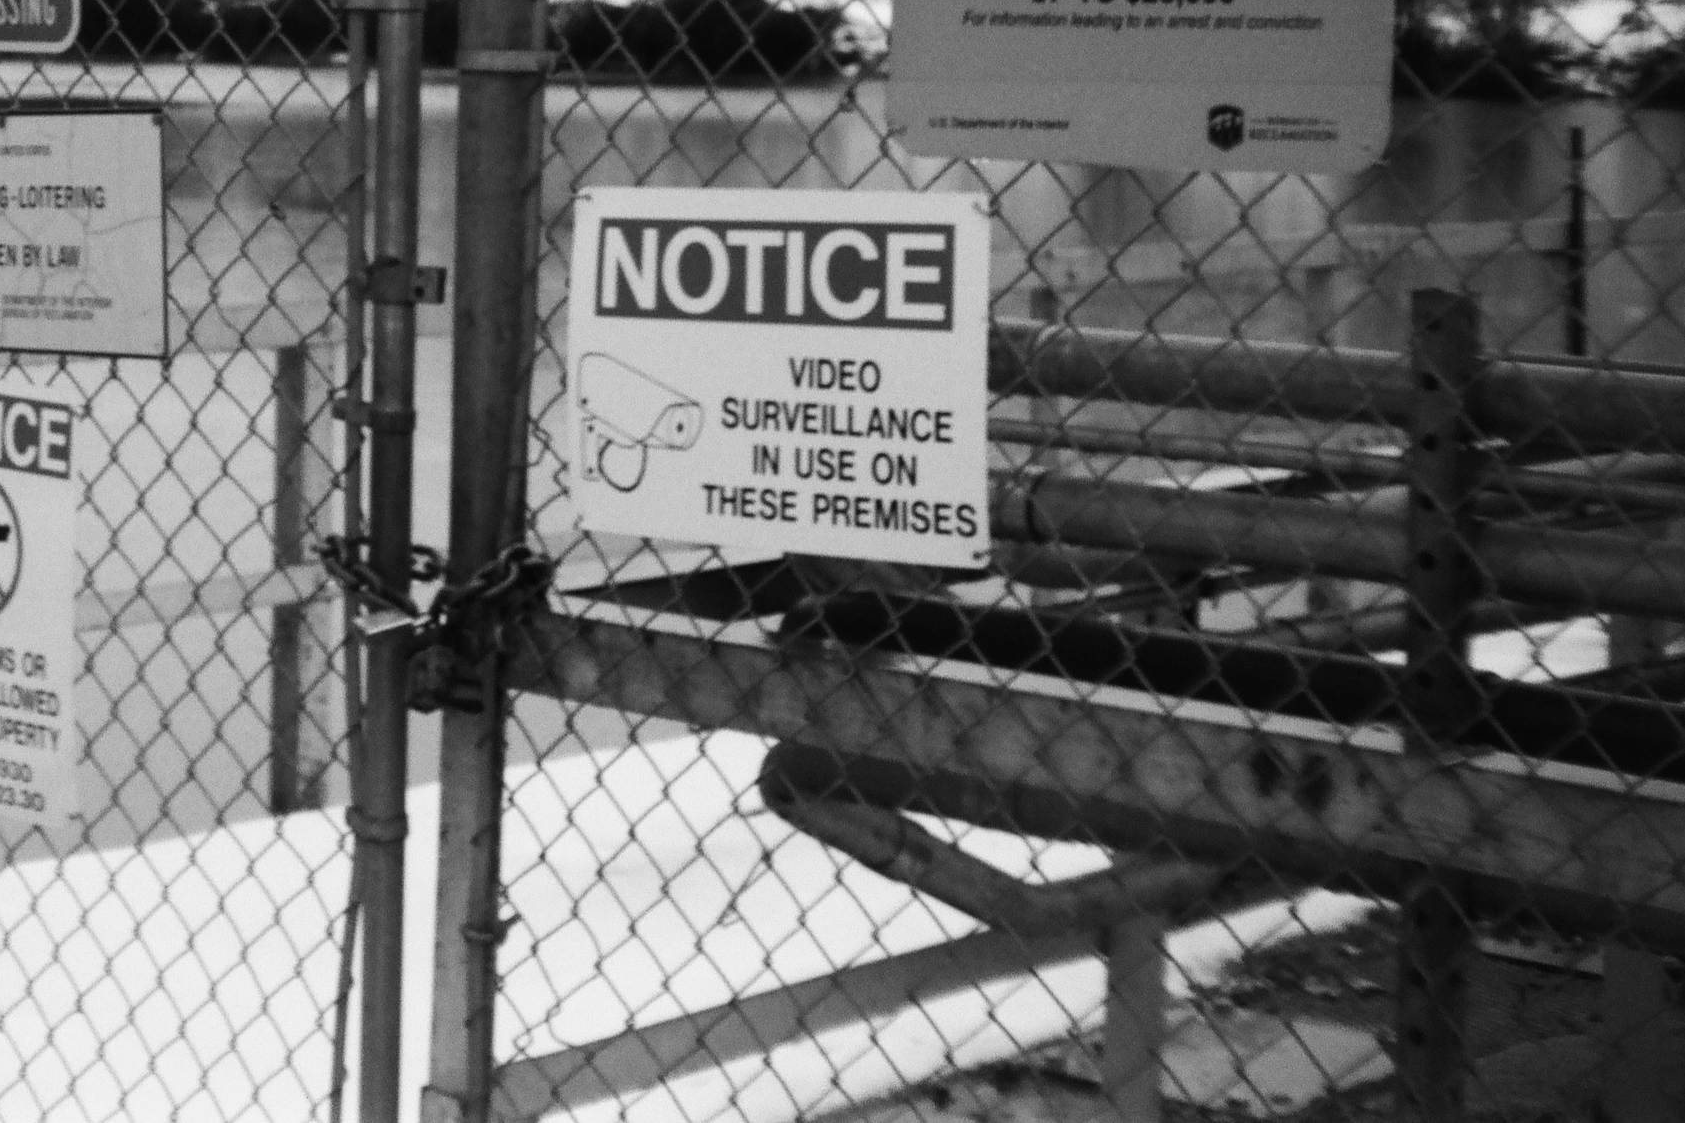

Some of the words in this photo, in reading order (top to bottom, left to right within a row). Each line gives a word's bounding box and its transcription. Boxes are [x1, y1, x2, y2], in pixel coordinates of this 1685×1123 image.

[22, 244, 43, 268] BY
[47, 245, 81, 268] LAW
[600, 225, 947, 322] NOTICE
[789, 356, 882, 393] VIDEO
[720, 396, 955, 444] SURVEILLANCE
[752, 444, 780, 477] IN
[794, 448, 857, 482] USE
[870, 452, 918, 487] ON
[702, 483, 799, 523] THESE
[813, 493, 979, 538] PREMISES
[21, 651, 48, 679] OR
